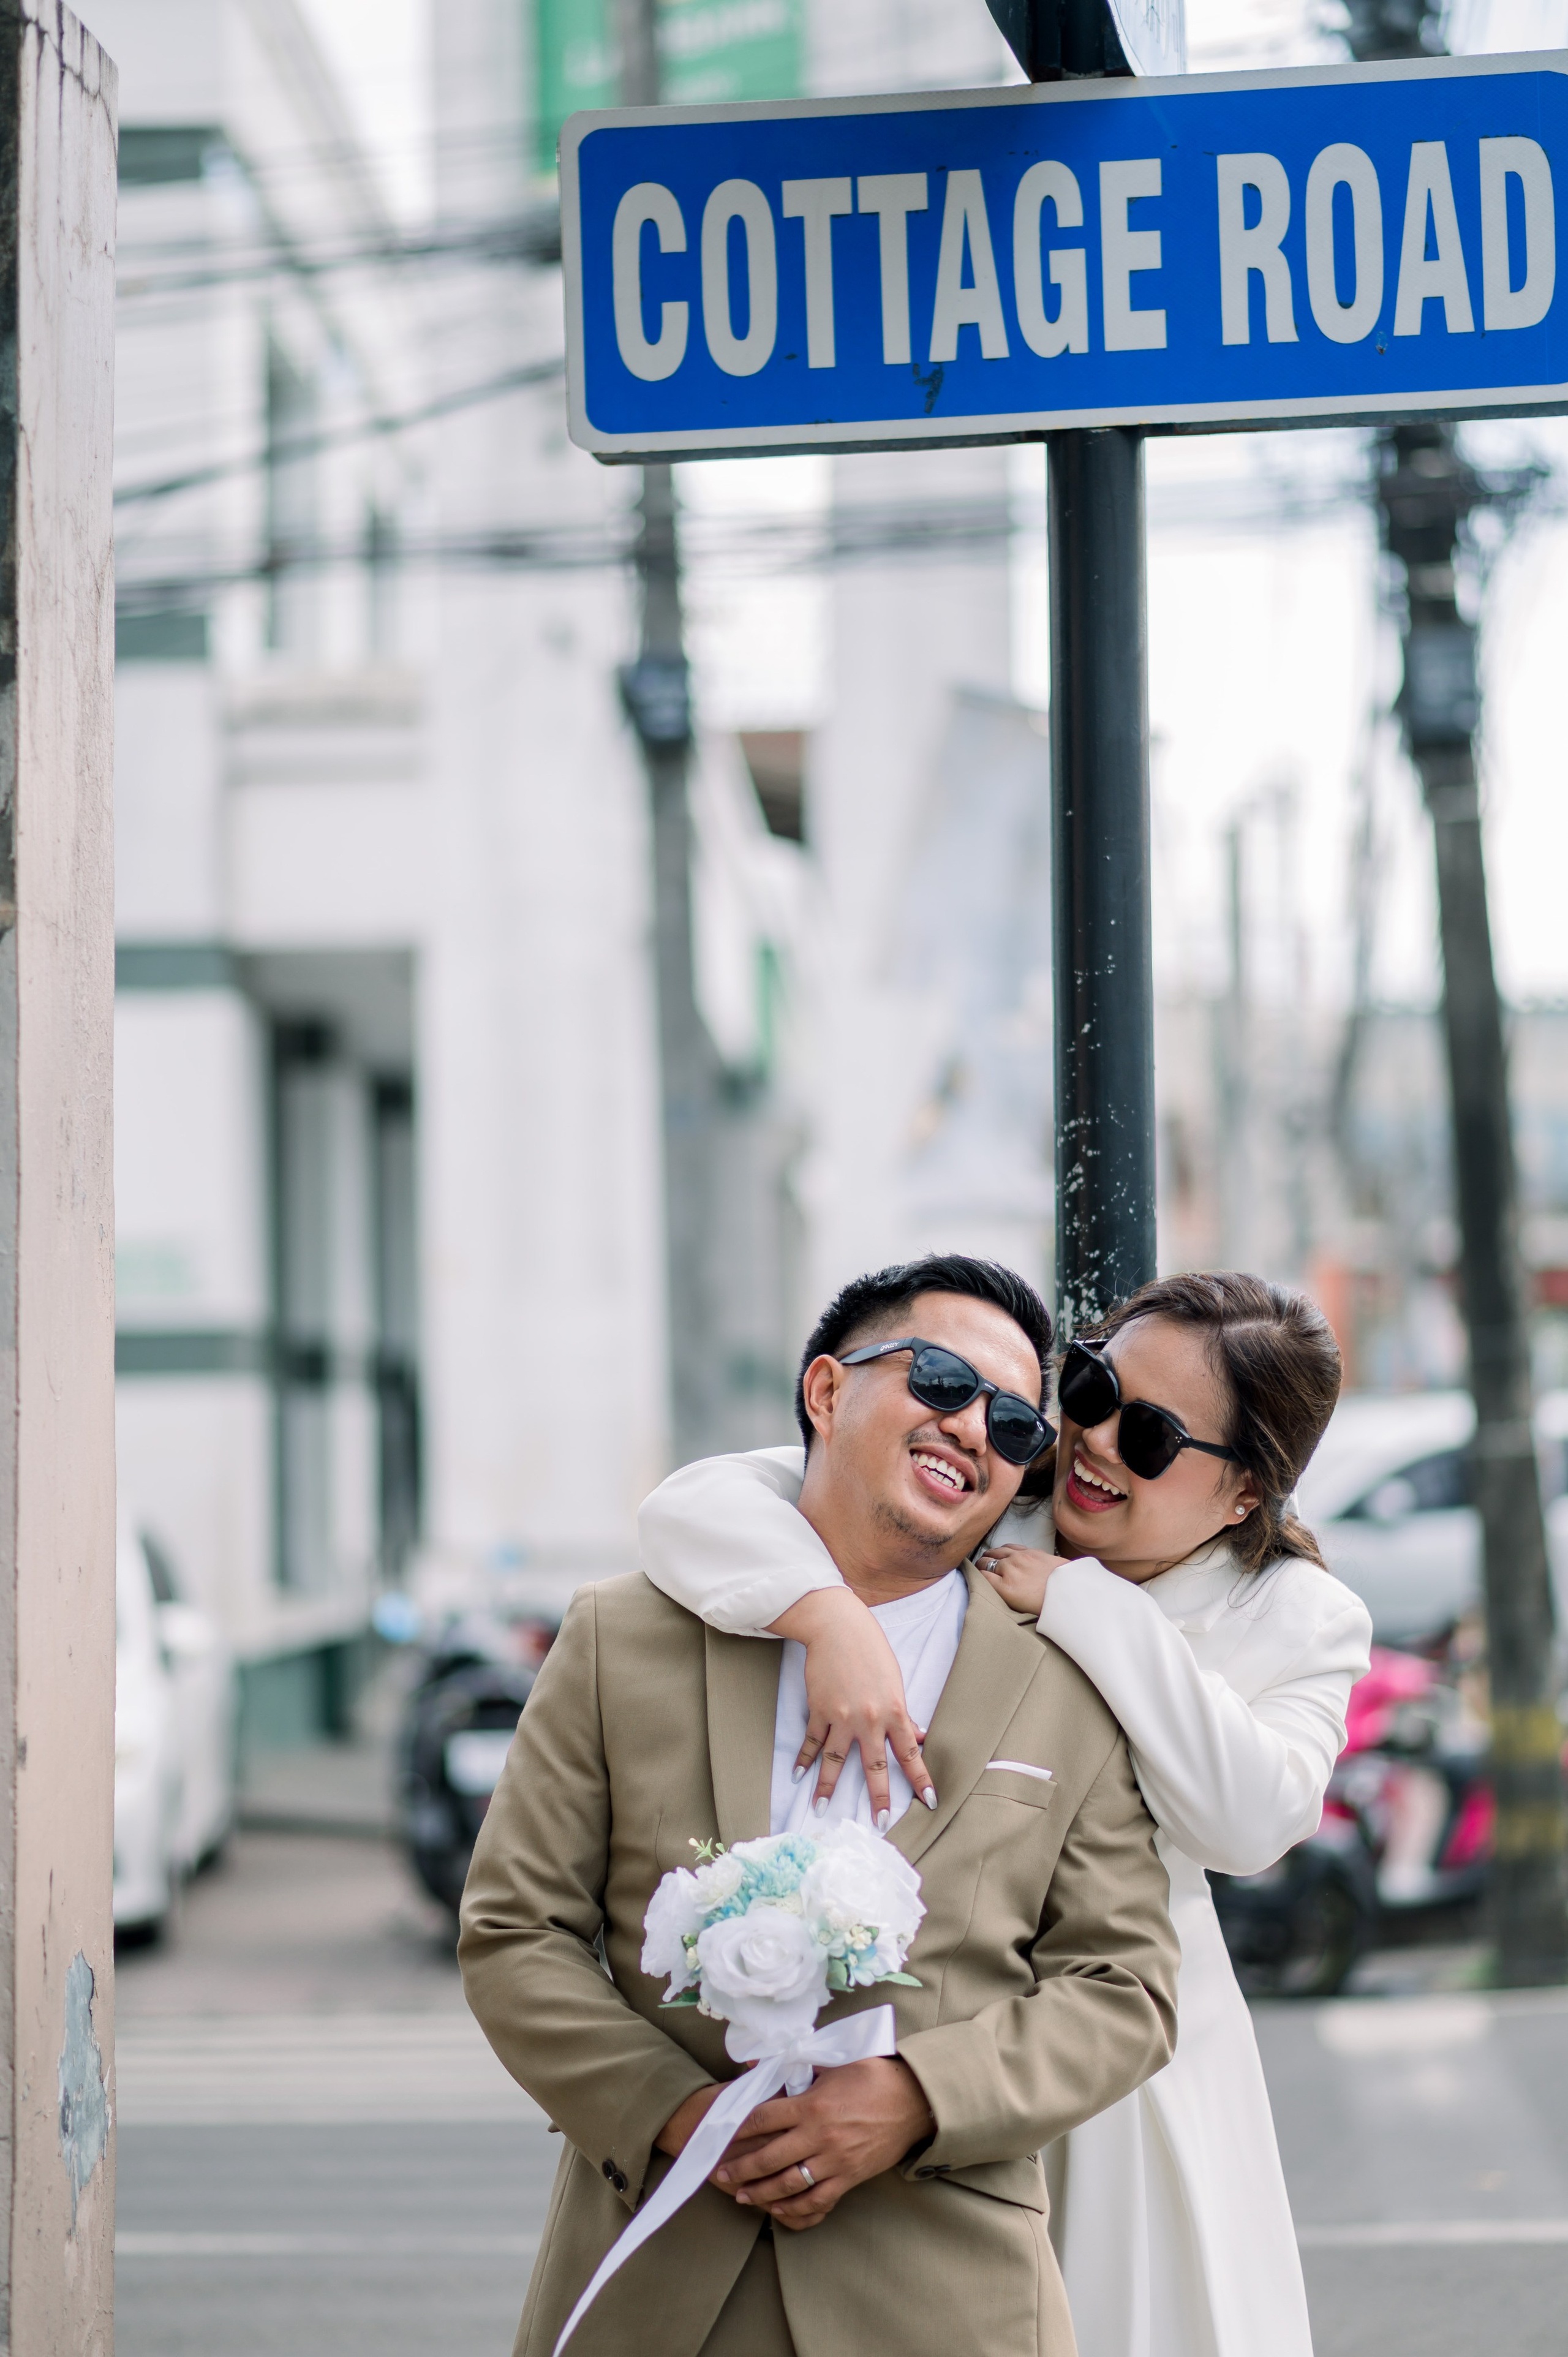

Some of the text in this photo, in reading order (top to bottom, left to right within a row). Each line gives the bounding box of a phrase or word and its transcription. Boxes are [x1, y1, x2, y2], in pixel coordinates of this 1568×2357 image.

[612, 136, 1556, 382] COTTAGE ROAD
[880, 1342, 900, 1351] OAKLEY
